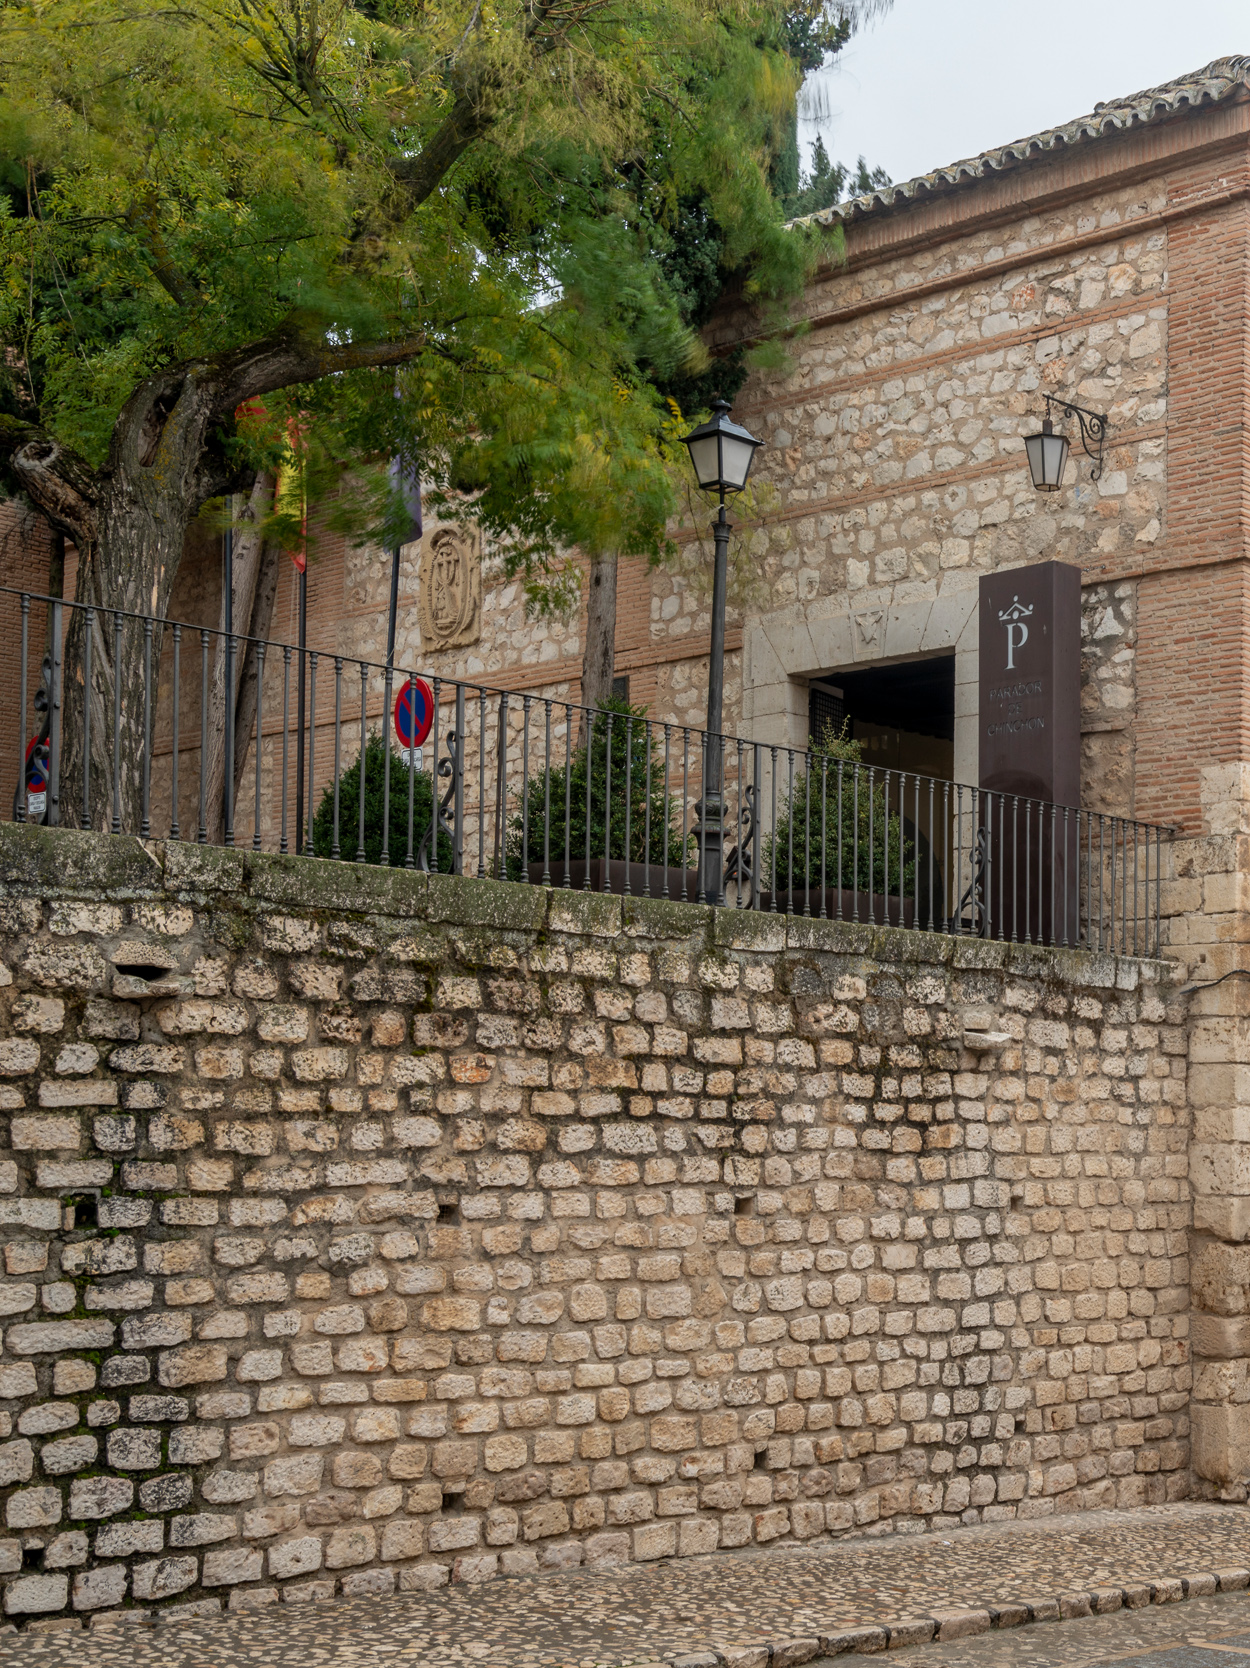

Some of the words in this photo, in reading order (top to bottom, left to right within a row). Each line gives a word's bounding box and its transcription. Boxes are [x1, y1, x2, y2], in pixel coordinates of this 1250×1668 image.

[1004, 622, 1029, 670] P
[989, 680, 1042, 701] PARADOR
[1008, 701, 1022, 715] DE
